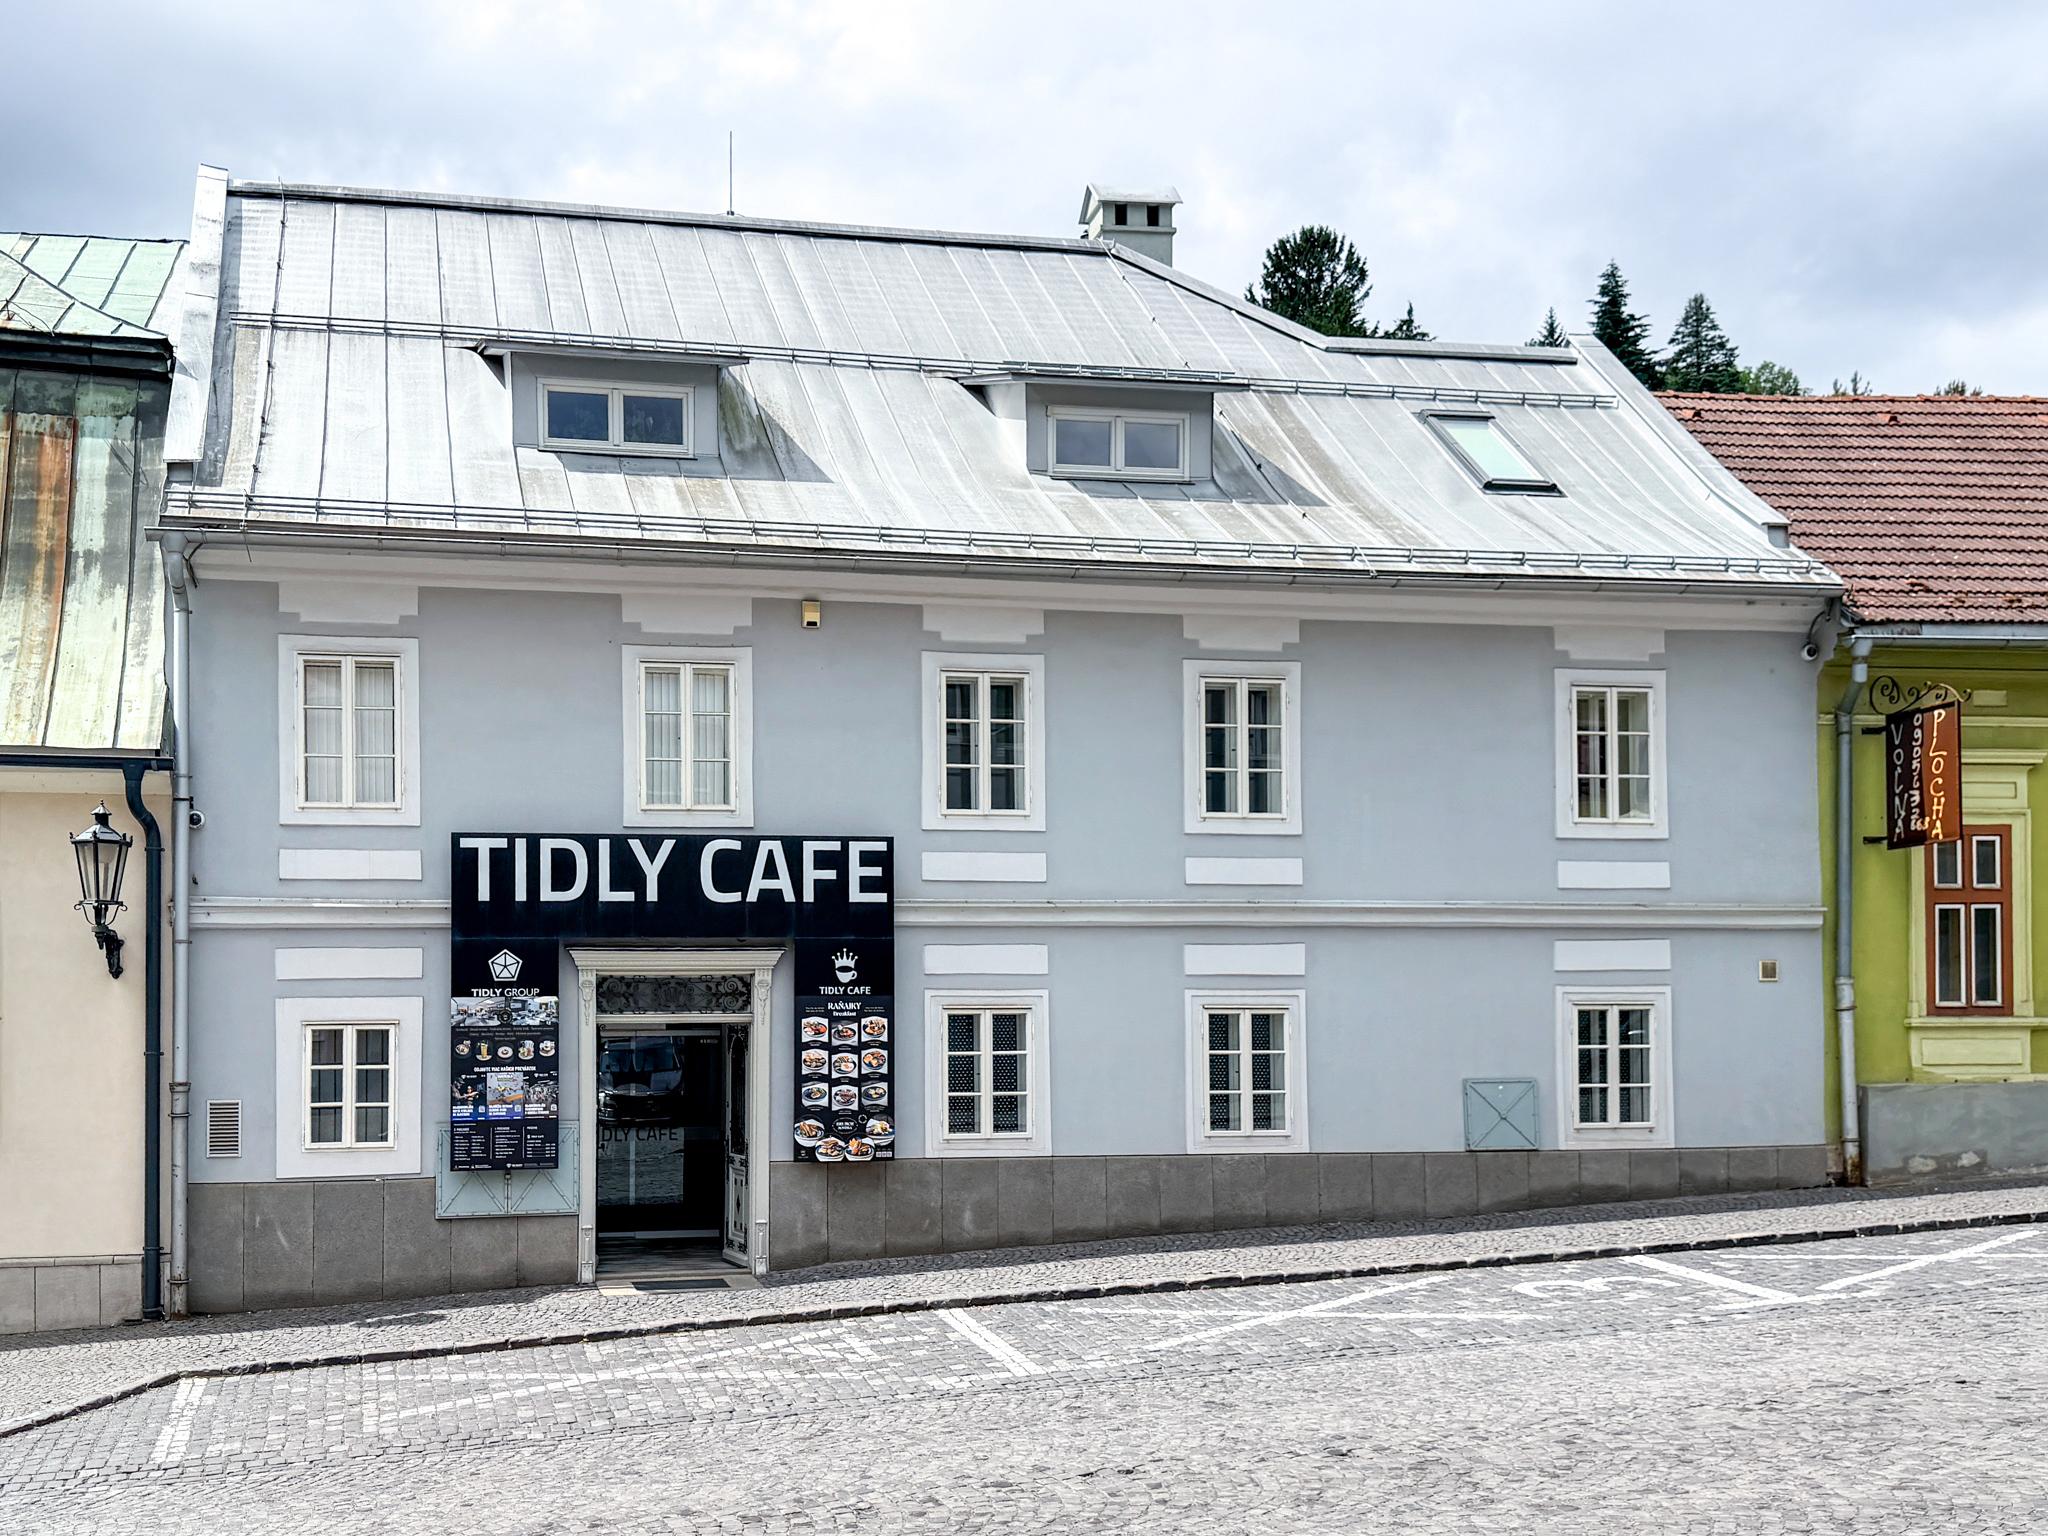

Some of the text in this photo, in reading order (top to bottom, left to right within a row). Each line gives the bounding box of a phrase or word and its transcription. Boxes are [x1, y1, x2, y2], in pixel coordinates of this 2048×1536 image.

[1929, 709, 1948, 841] PLOCHA
[459, 837, 889, 904] TIDLY CAFE
[471, 988, 540, 997] TIDLY GROUP
[819, 986, 872, 995] TIDLY CAFE
[636, 1126, 678, 1141] CAFE
